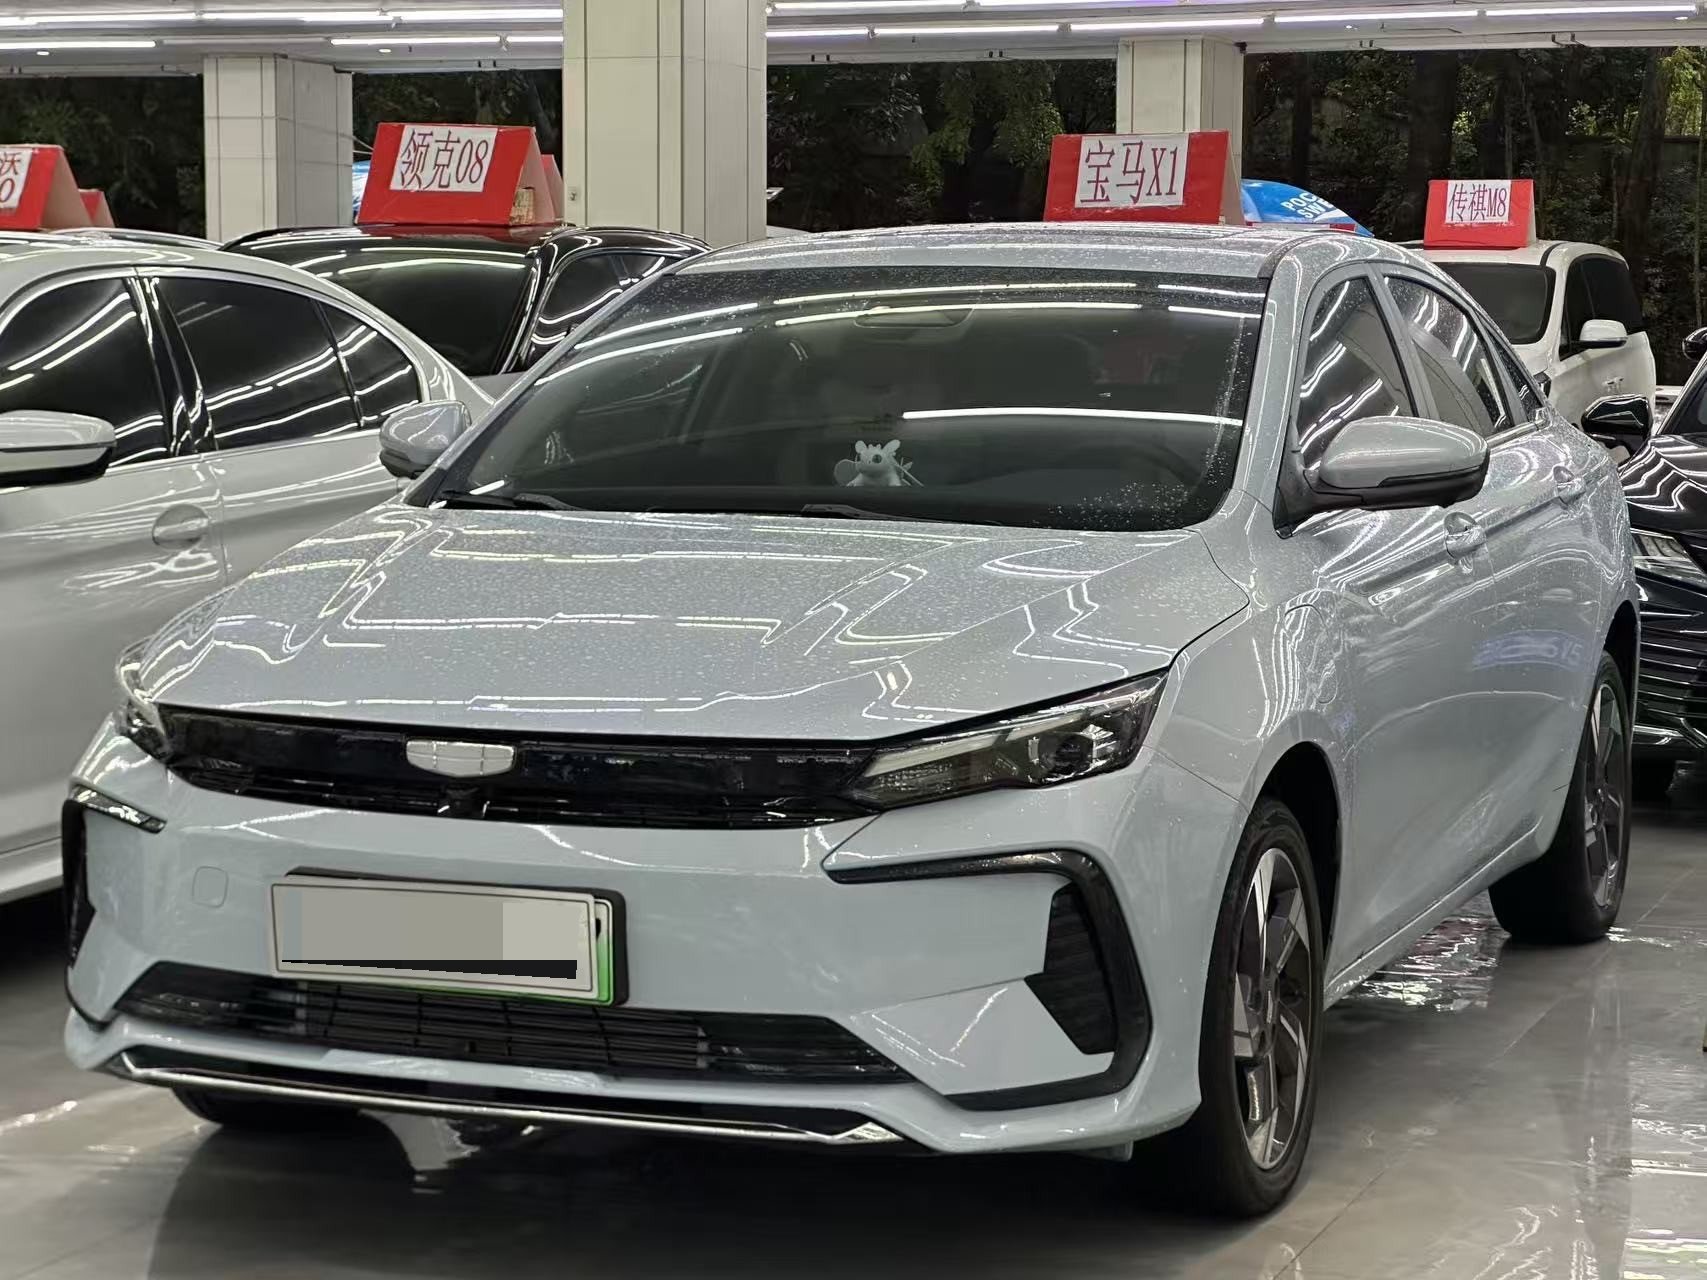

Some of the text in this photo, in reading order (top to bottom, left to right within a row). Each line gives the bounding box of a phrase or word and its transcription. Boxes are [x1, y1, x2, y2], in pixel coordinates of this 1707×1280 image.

[400, 128, 489, 188] 领克08
[1080, 140, 1178, 204] 宝马X1
[1448, 183, 1507, 222] 传祺M8
